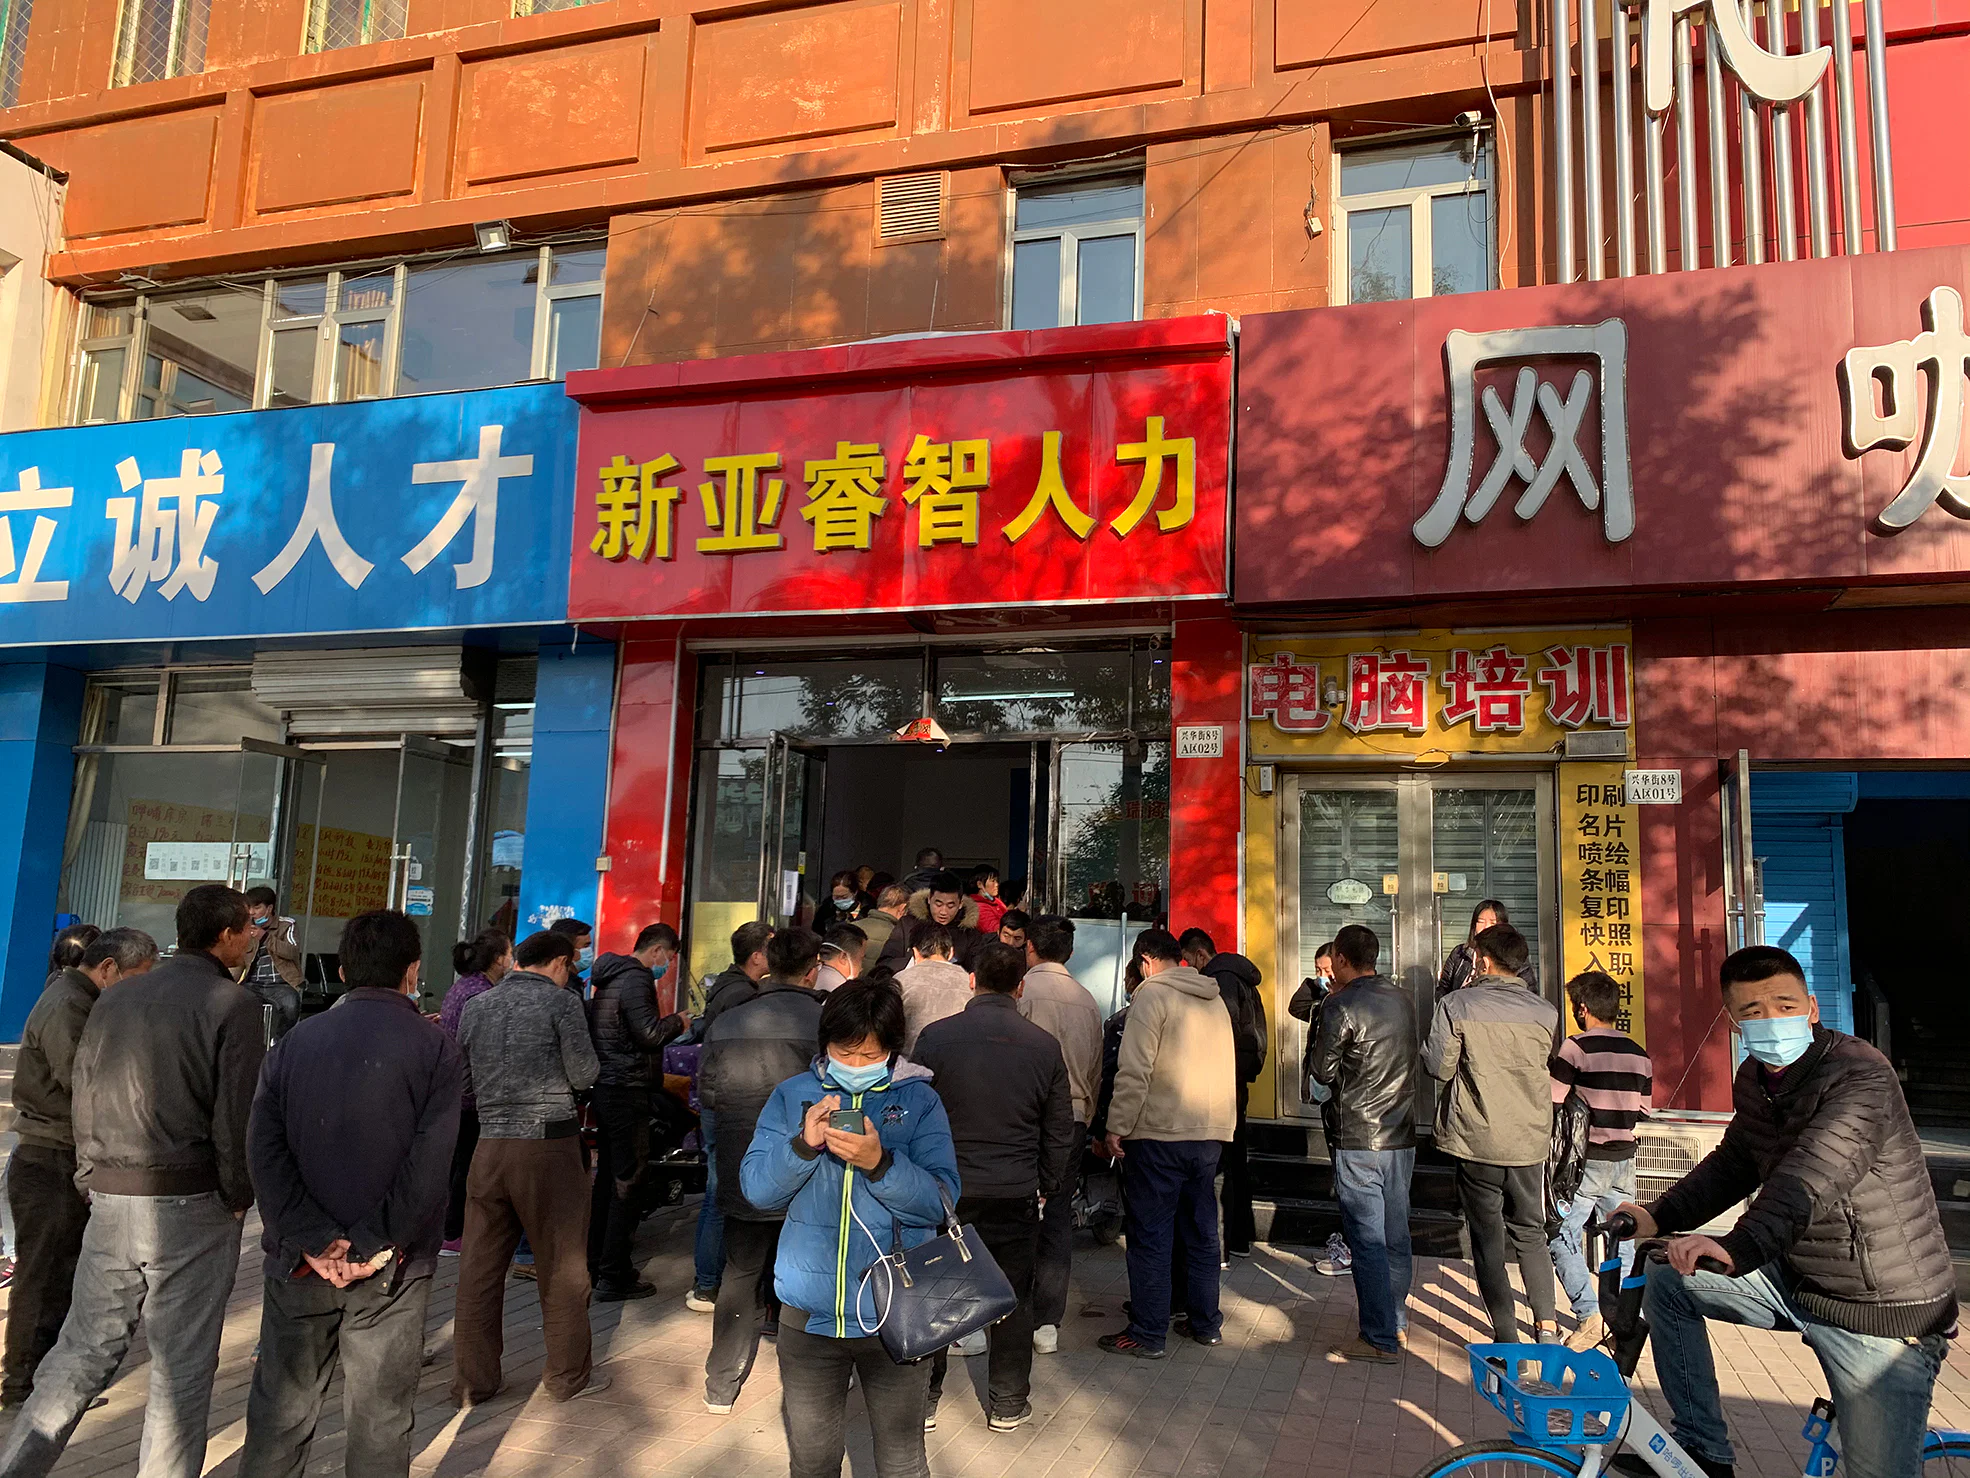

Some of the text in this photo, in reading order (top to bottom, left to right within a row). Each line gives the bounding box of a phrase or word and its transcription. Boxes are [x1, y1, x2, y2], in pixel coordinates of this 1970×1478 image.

[588, 415, 1198, 560] 新亚睿智人力
[0, 424, 534, 604] 立诚人才
[1247, 643, 1632, 733] 电脑培训
[1181, 730, 1219, 741] 兴华街8号
[1181, 743, 1219, 754] A区02号
[1631, 774, 1676, 785] 兴华街8号
[1632, 788, 1676, 800] A区01号
